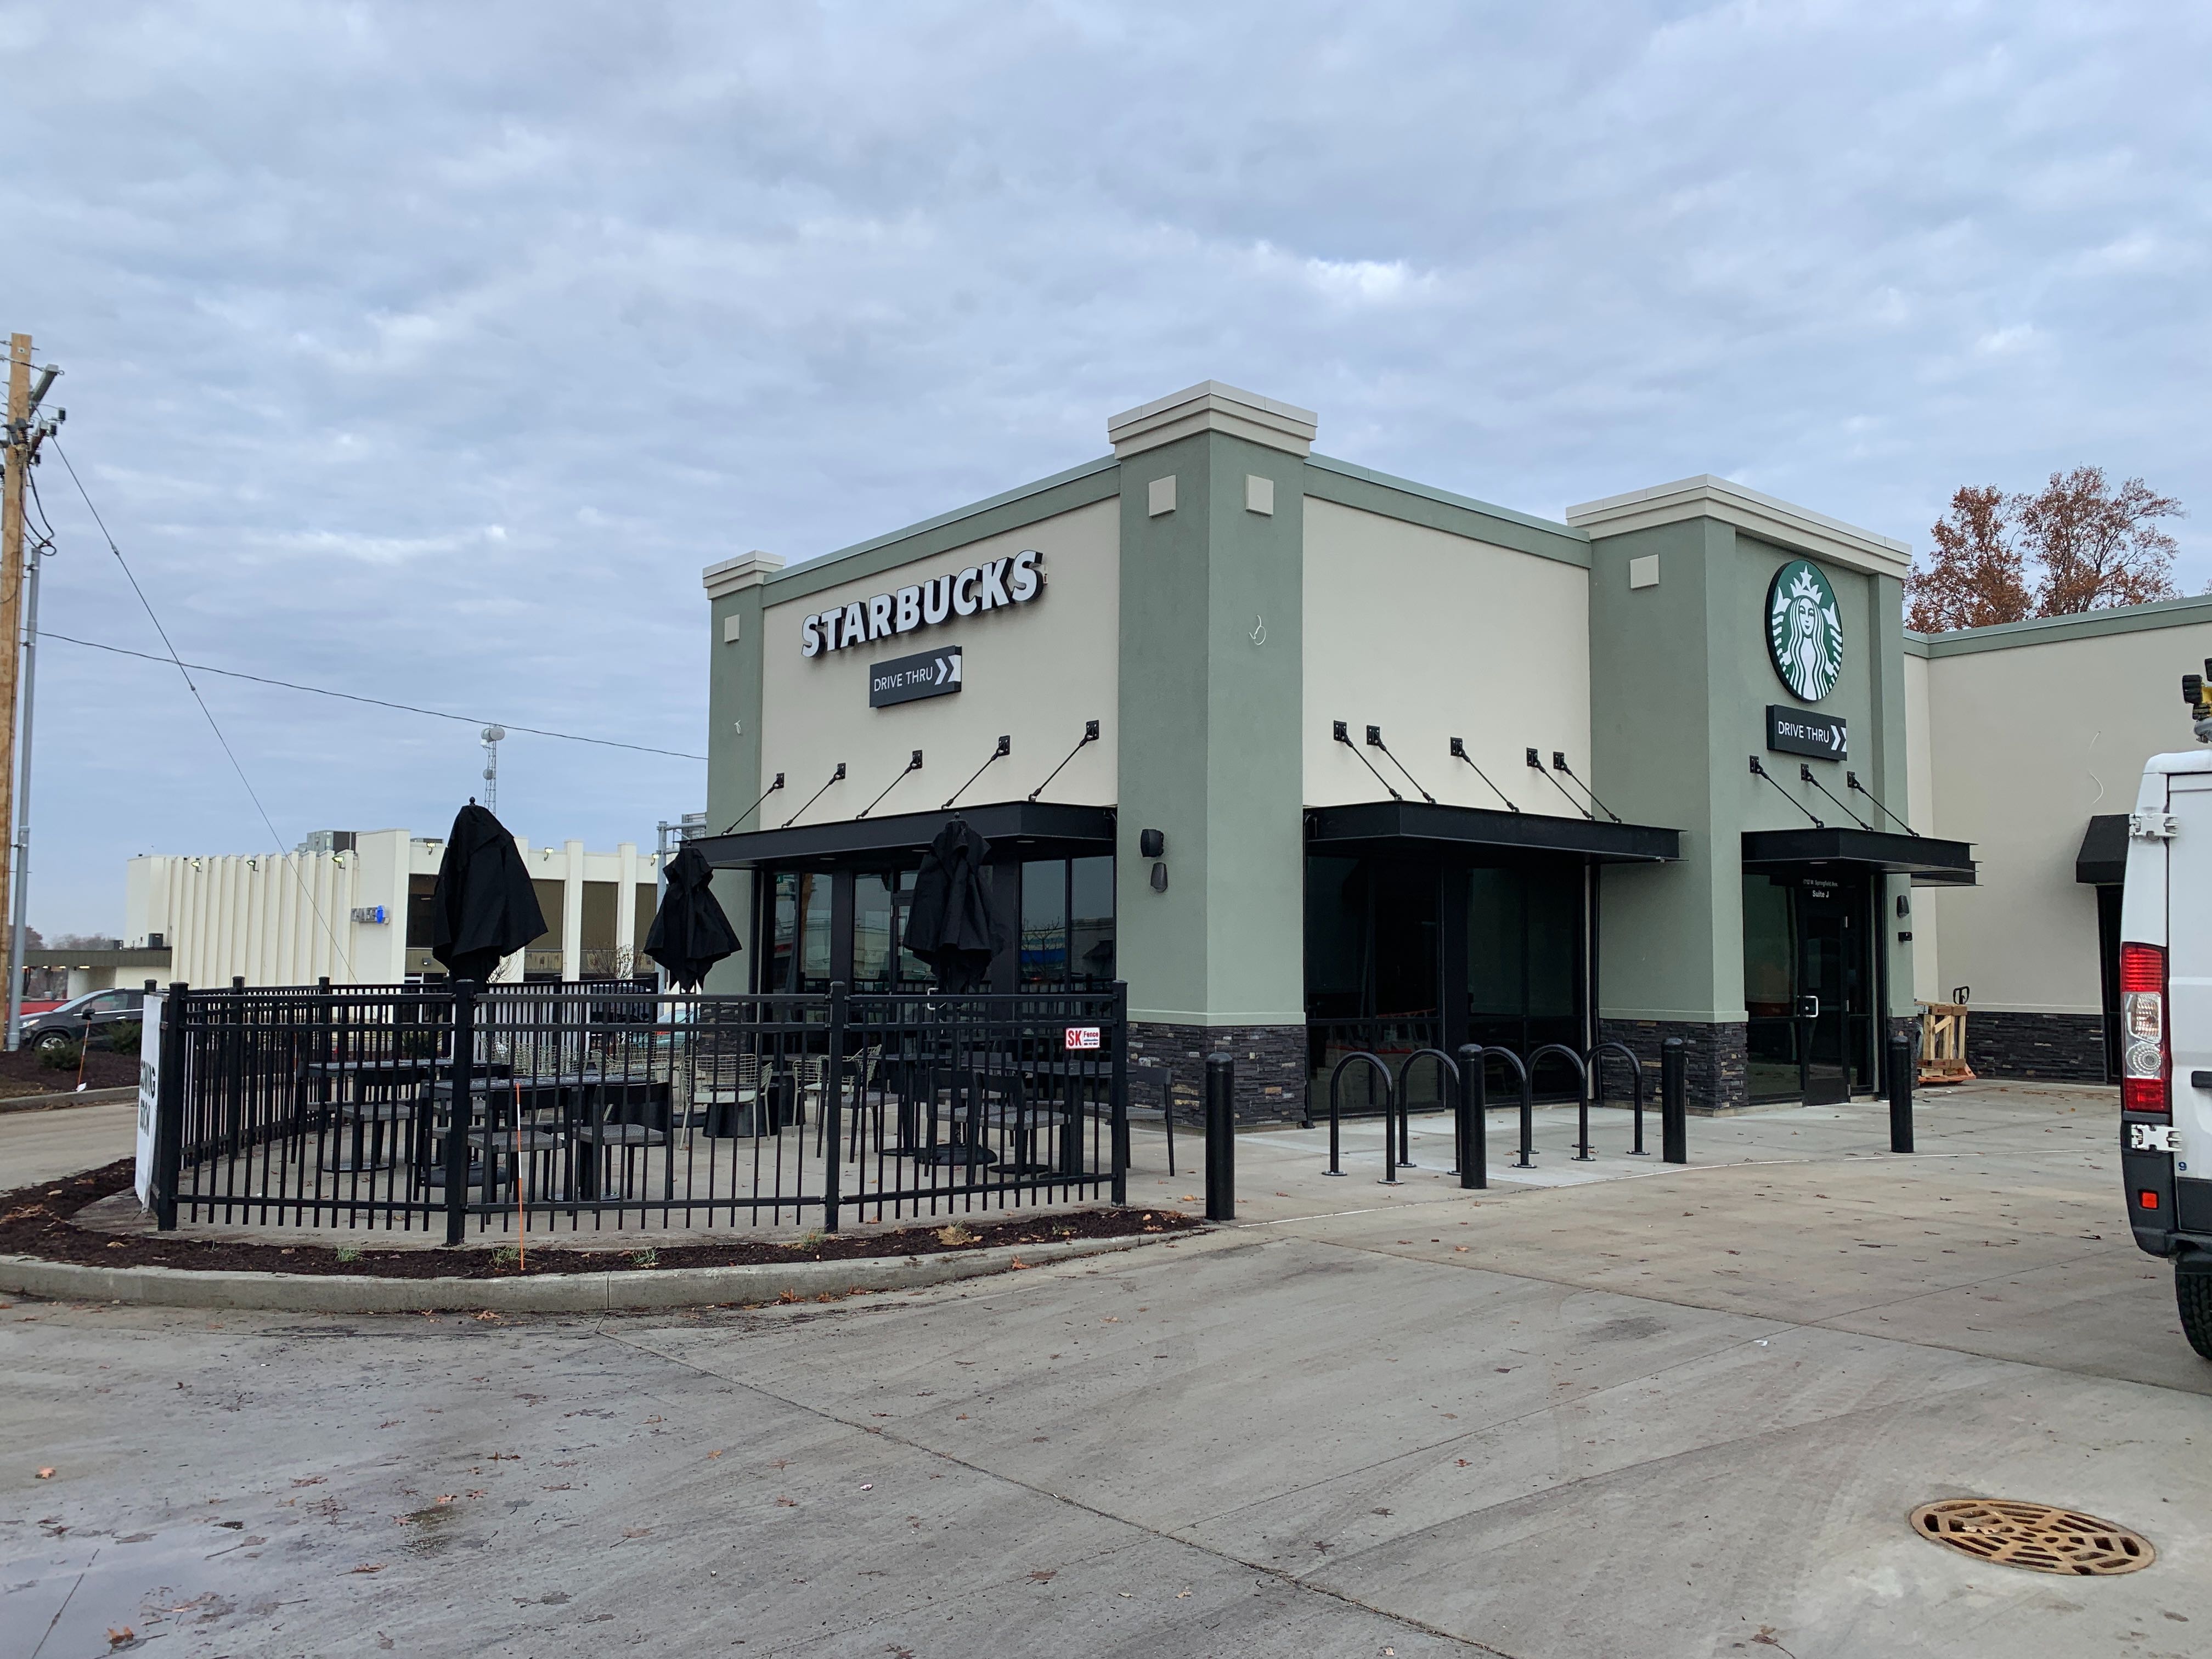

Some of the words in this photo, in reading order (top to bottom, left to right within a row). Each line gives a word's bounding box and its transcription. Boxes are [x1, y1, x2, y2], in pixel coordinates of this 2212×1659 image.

[801, 549, 1043, 658] STARBUCKS
[874, 673, 903, 692] DRIVE
[905, 666, 933, 685] THRU
[1778, 720, 1804, 738] DRIVE
[1806, 726, 1829, 743] THRU
[1812, 890, 1825, 898] Suite
[1068, 1030, 1082, 1046] SK
[2178, 1161, 2187, 1171] 9
